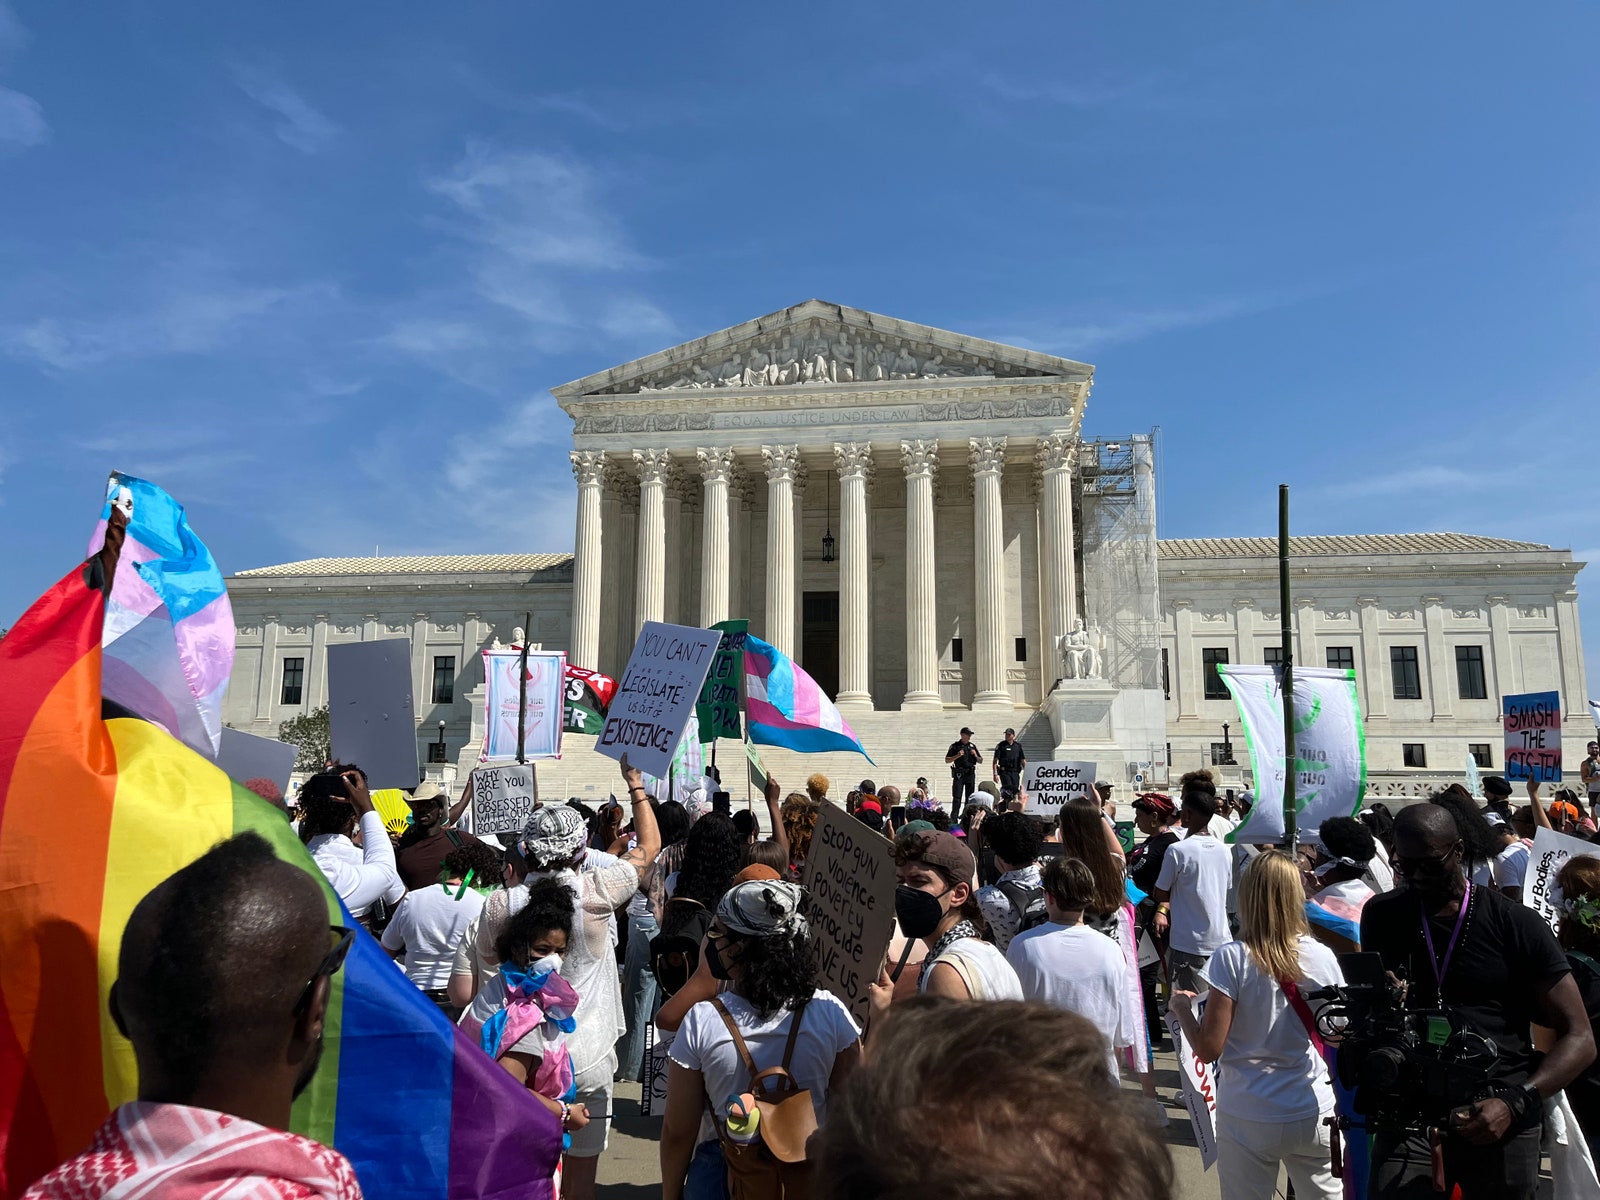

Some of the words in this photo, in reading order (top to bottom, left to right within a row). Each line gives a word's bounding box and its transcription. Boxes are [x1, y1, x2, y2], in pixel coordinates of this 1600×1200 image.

[723, 414, 767, 427] EQUAL
[772, 412, 825, 426] JUSTICE
[831, 410, 879, 423] UNDER
[882, 408, 910, 421] LAW
[641, 632, 667, 658] YOU
[666, 639, 708, 665] CAN'T
[622, 669, 684, 705] LEGISLATE
[628, 701, 639, 713] US
[639, 704, 652, 717] OUT
[652, 708, 663, 719] OF
[1509, 702, 1554, 729] SMASH
[601, 717, 674, 753] EXISTENCE
[1520, 729, 1546, 750] THE
[475, 770, 499, 782] WHY
[1036, 766, 1081, 778] Gender
[476, 780, 500, 793] ARE
[505, 776, 525, 788] YOU
[1026, 779, 1087, 792] Liberation
[477, 790, 493, 803] SO
[477, 796, 531, 814] OBSESSED
[477, 810, 505, 823] WITH
[510, 808, 531, 818] OUR
[1532, 850, 1556, 897] Bodies,
[1533, 896, 1542, 911] ur
[645, 1024, 653, 1049] GENDER
